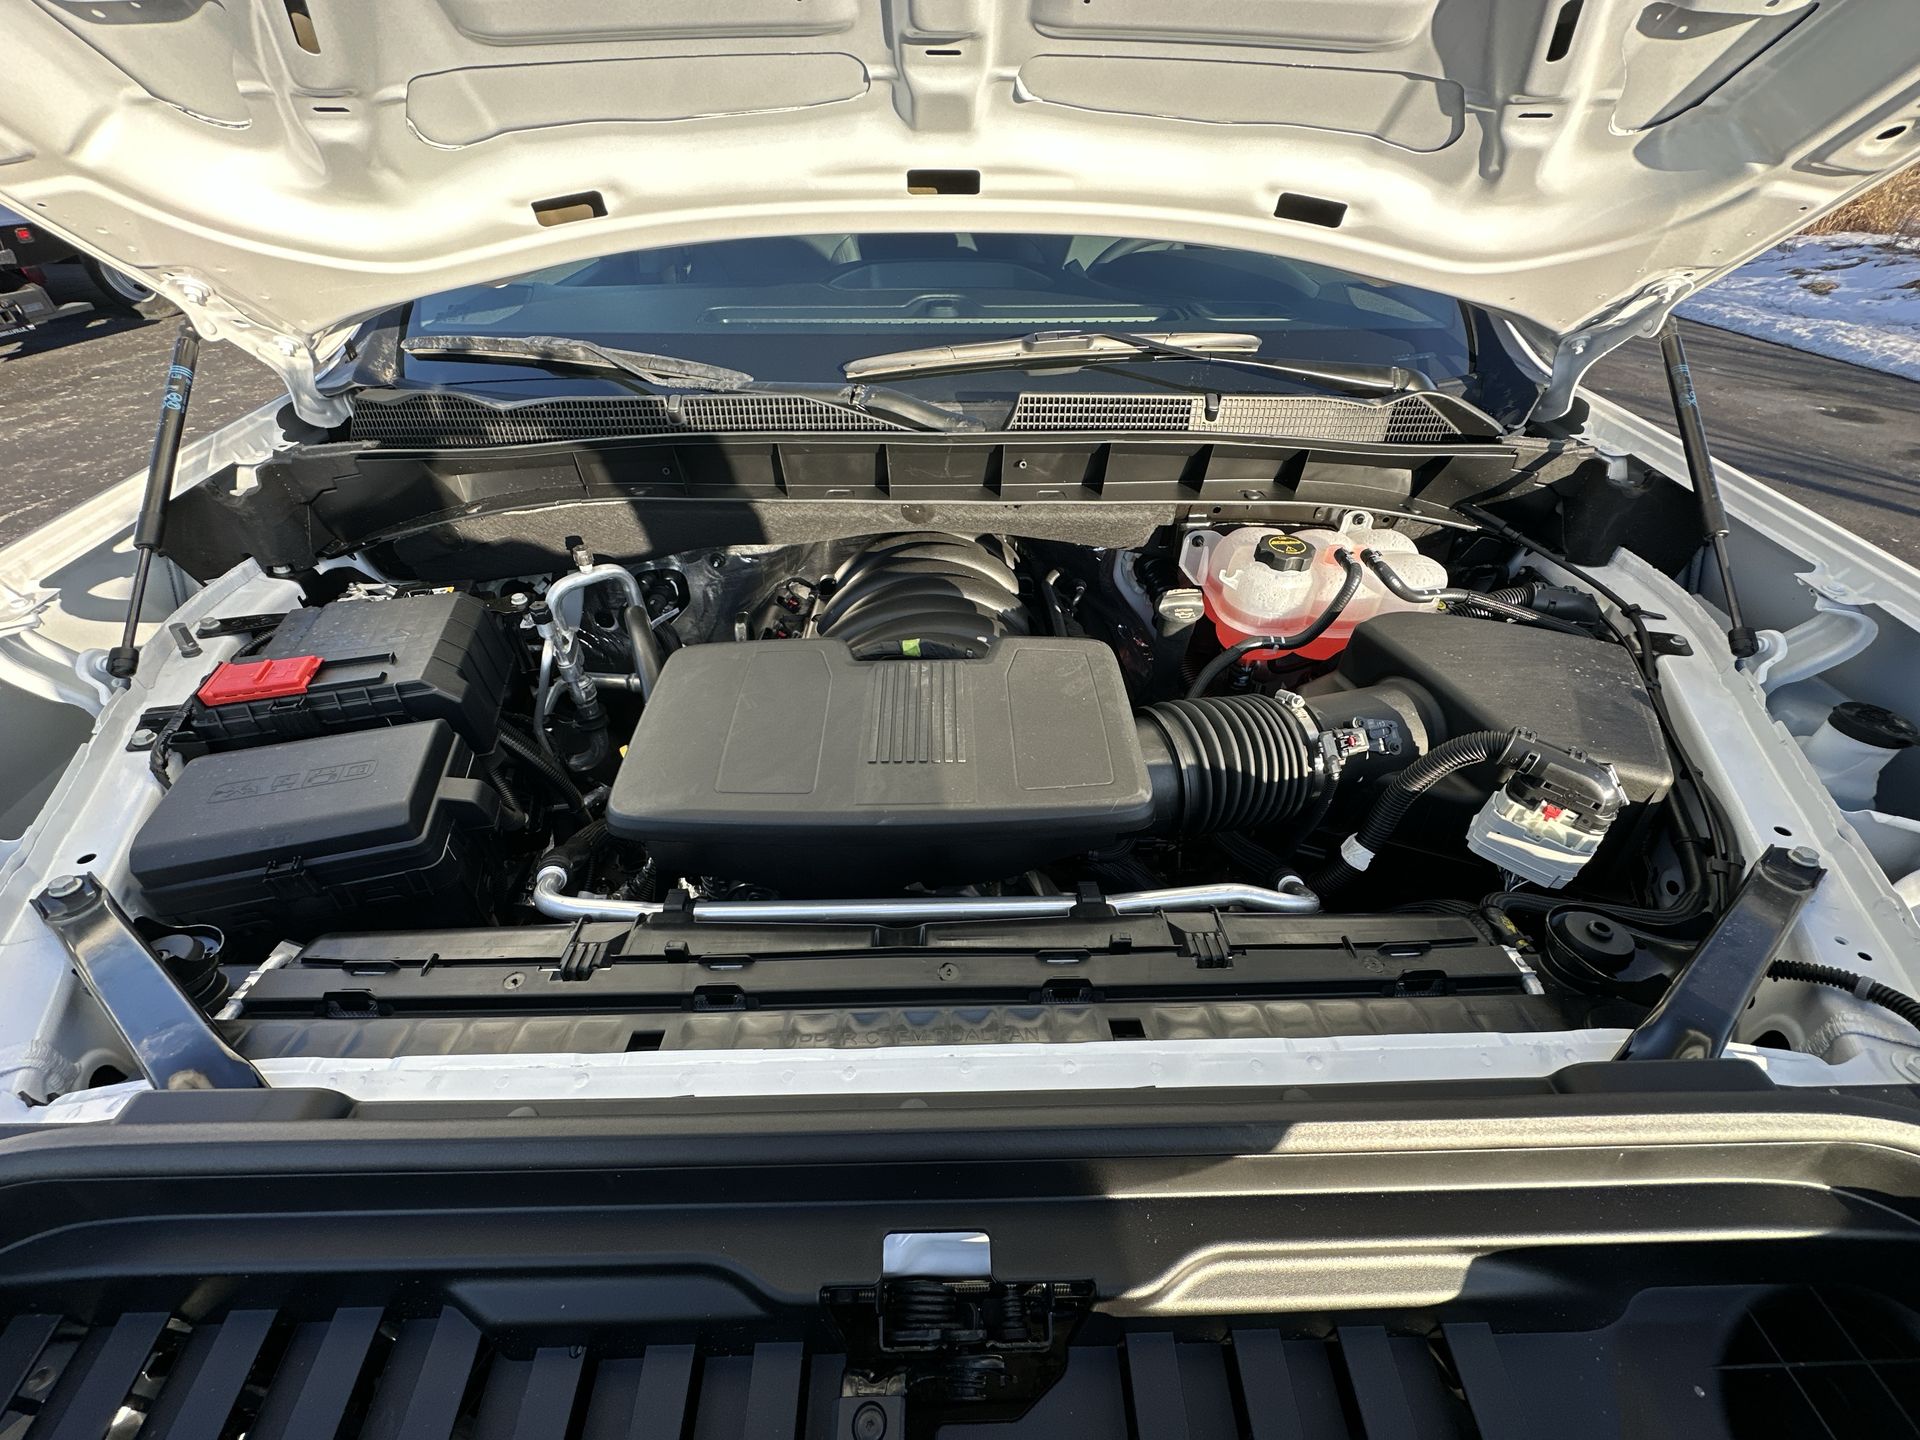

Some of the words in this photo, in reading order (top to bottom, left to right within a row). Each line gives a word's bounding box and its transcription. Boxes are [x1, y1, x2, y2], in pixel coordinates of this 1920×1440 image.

[783, 1031, 858, 1048] UPPER
[933, 1027, 993, 1043] DUAL
[1002, 1025, 1040, 1042] FAN
